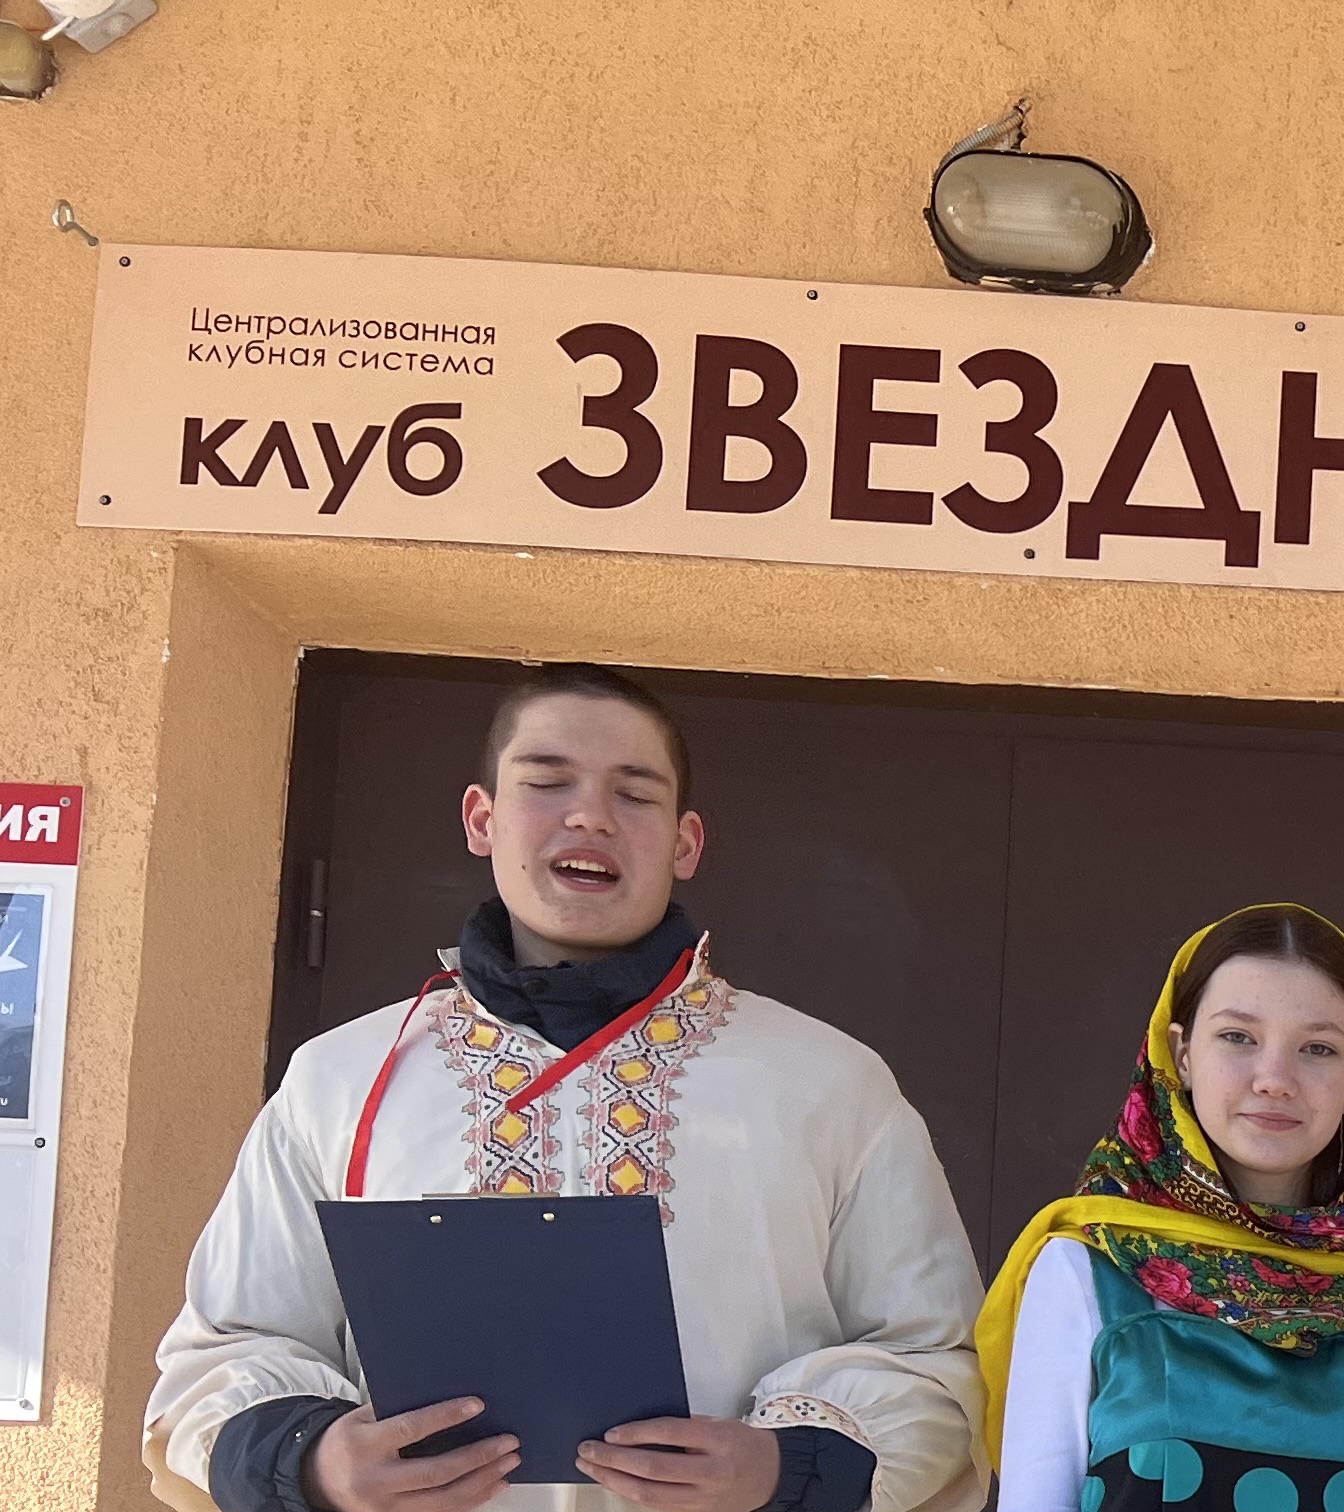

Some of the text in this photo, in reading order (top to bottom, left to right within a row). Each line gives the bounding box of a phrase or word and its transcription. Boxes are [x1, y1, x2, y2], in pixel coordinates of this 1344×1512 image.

[190, 306, 496, 345] Централизованная
[187, 339, 495, 376] клубная система
[179, 402, 464, 515] клуб
